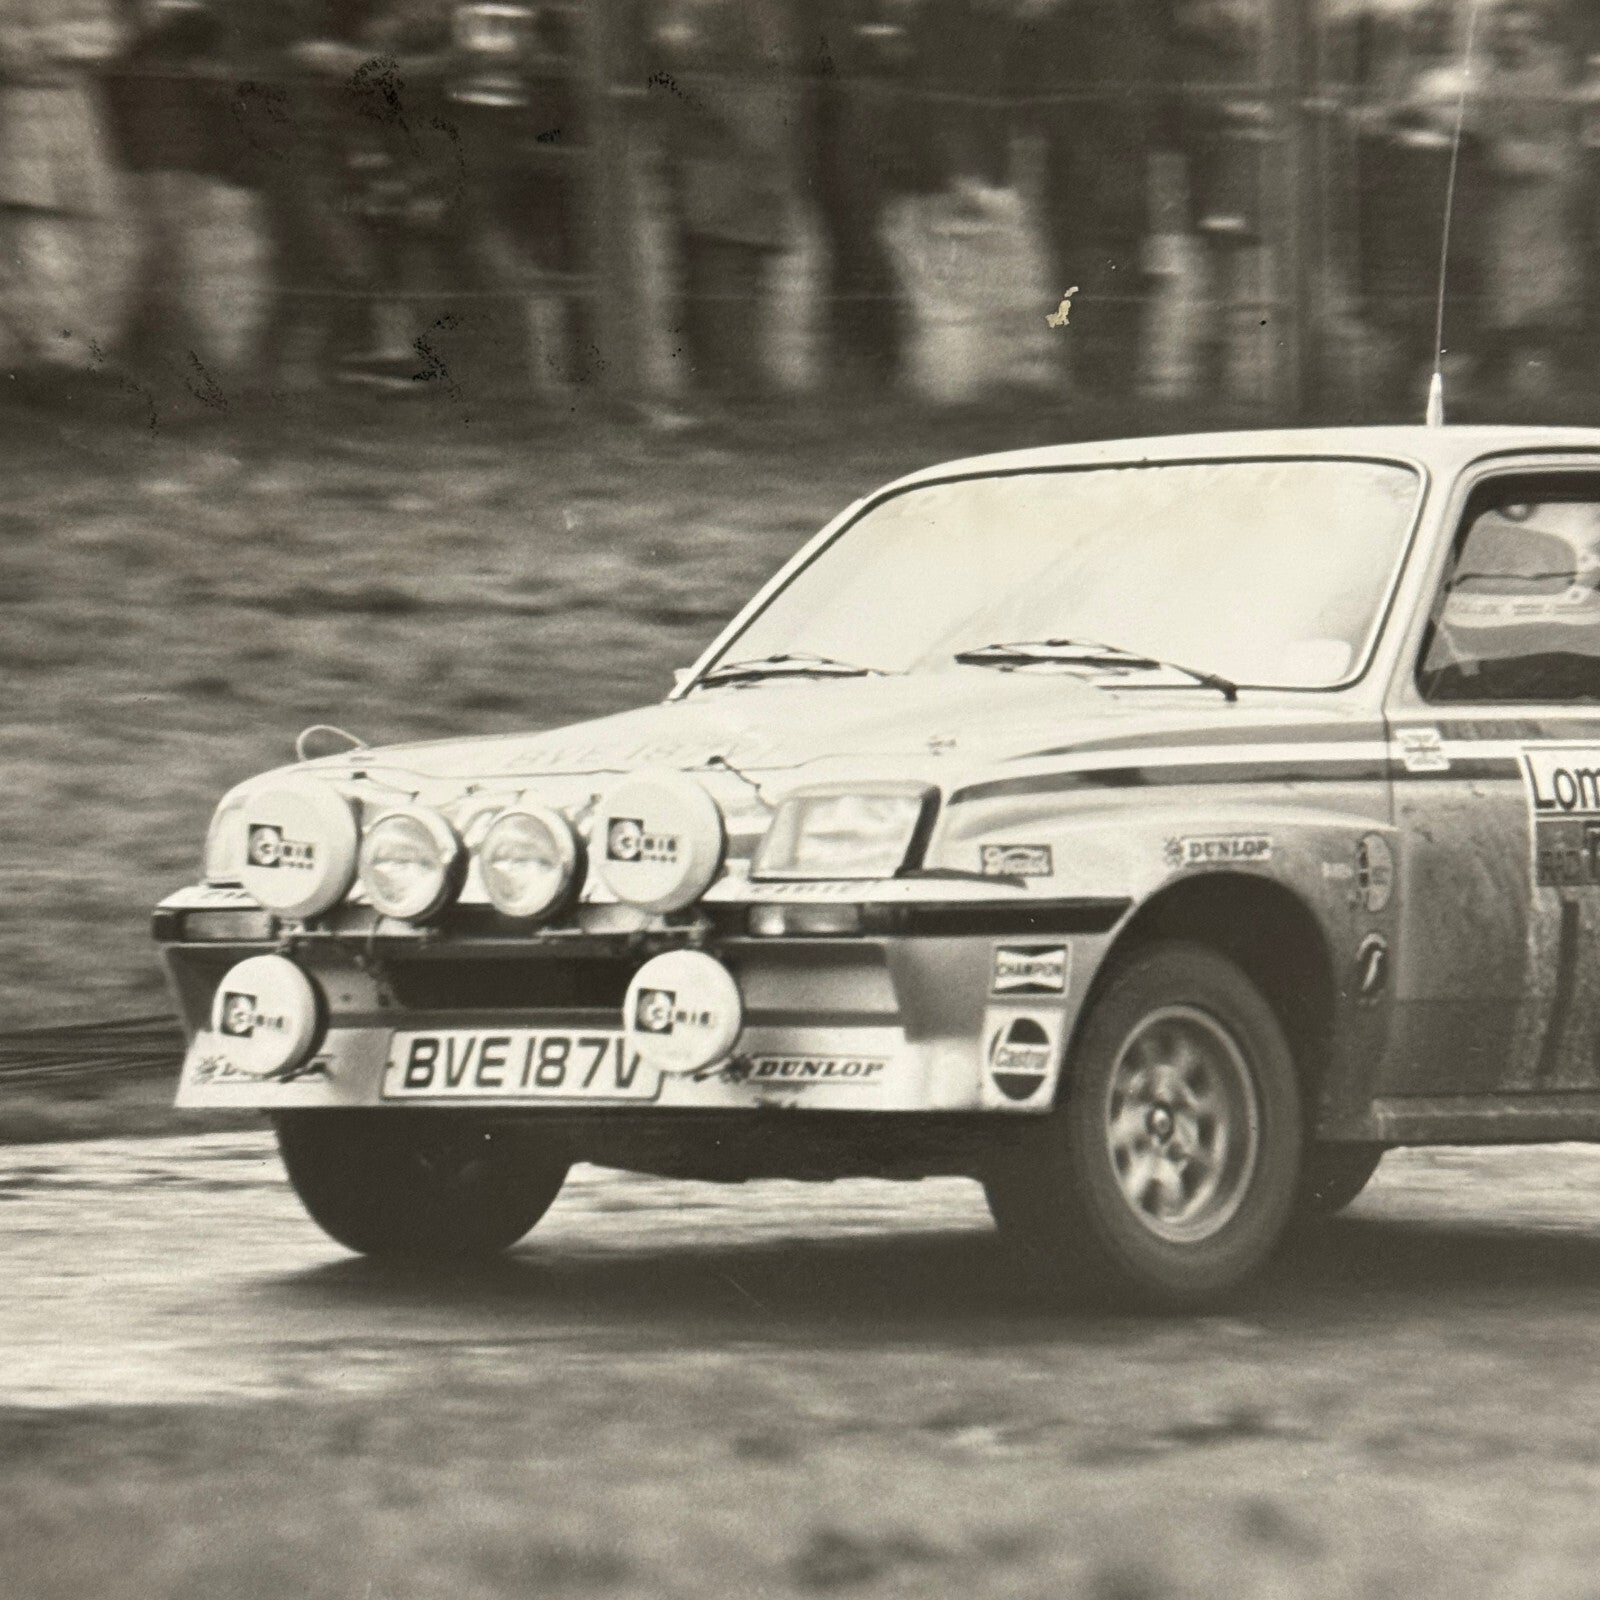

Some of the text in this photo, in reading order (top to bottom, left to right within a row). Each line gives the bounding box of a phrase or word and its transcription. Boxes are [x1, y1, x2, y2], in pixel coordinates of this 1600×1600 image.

[1189, 841, 1269, 857] DUNLOP
[405, 1036, 642, 1088] BVE 187V
[756, 1061, 885, 1077] DUNLOP
